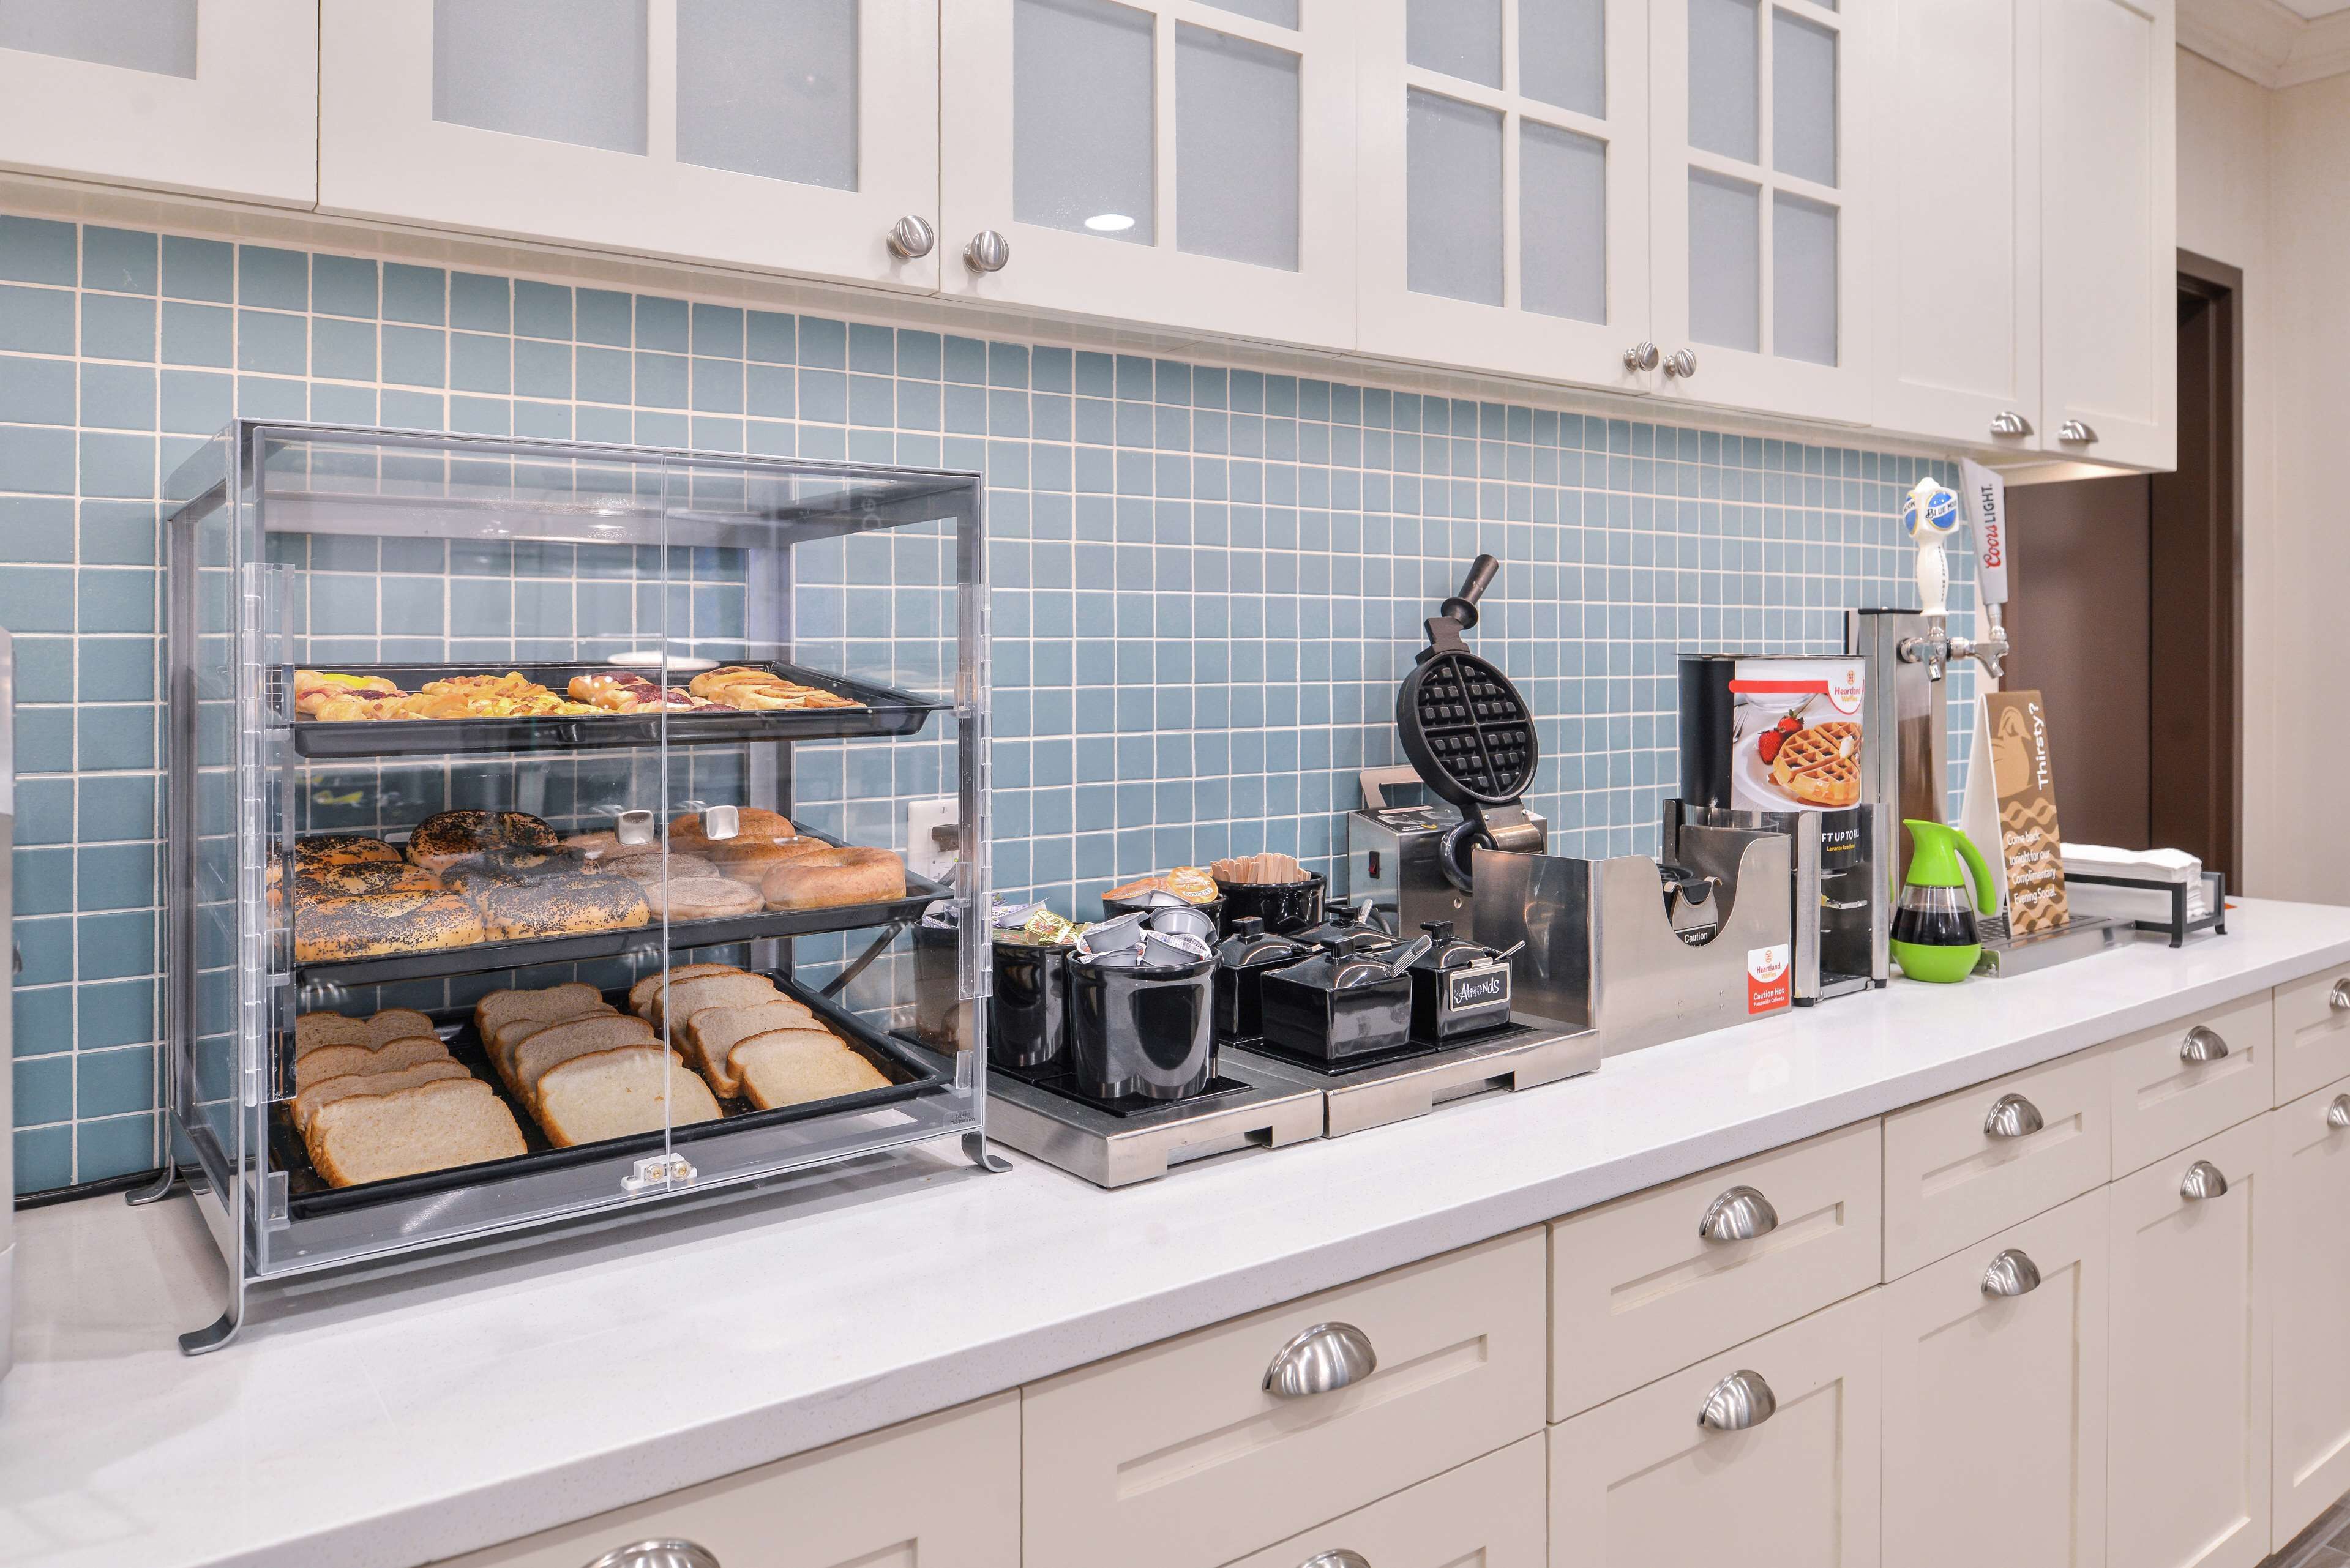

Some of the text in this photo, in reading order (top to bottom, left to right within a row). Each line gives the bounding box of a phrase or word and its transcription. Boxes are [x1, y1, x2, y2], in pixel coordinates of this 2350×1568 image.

[1925, 504, 1946, 519] BLUE
[1983, 525, 2001, 568] Coors
[1835, 686, 1860, 695] Heartland
[2028, 703, 2049, 790] Thirsty?
[1821, 832, 1834, 843] FT
[1835, 832, 1845, 842] UP
[1846, 830, 1854, 841] TO
[2007, 831, 2041, 845] Come back
[2010, 851, 2032, 865] tonight
[2040, 850, 2051, 860] our
[2012, 868, 2056, 885] Complimentary
[2014, 884, 2057, 904] Evening Social.
[1684, 932, 1708, 943] Caution
[1756, 962, 1781, 974] Heartland
[1753, 990, 1773, 1000] Caution
